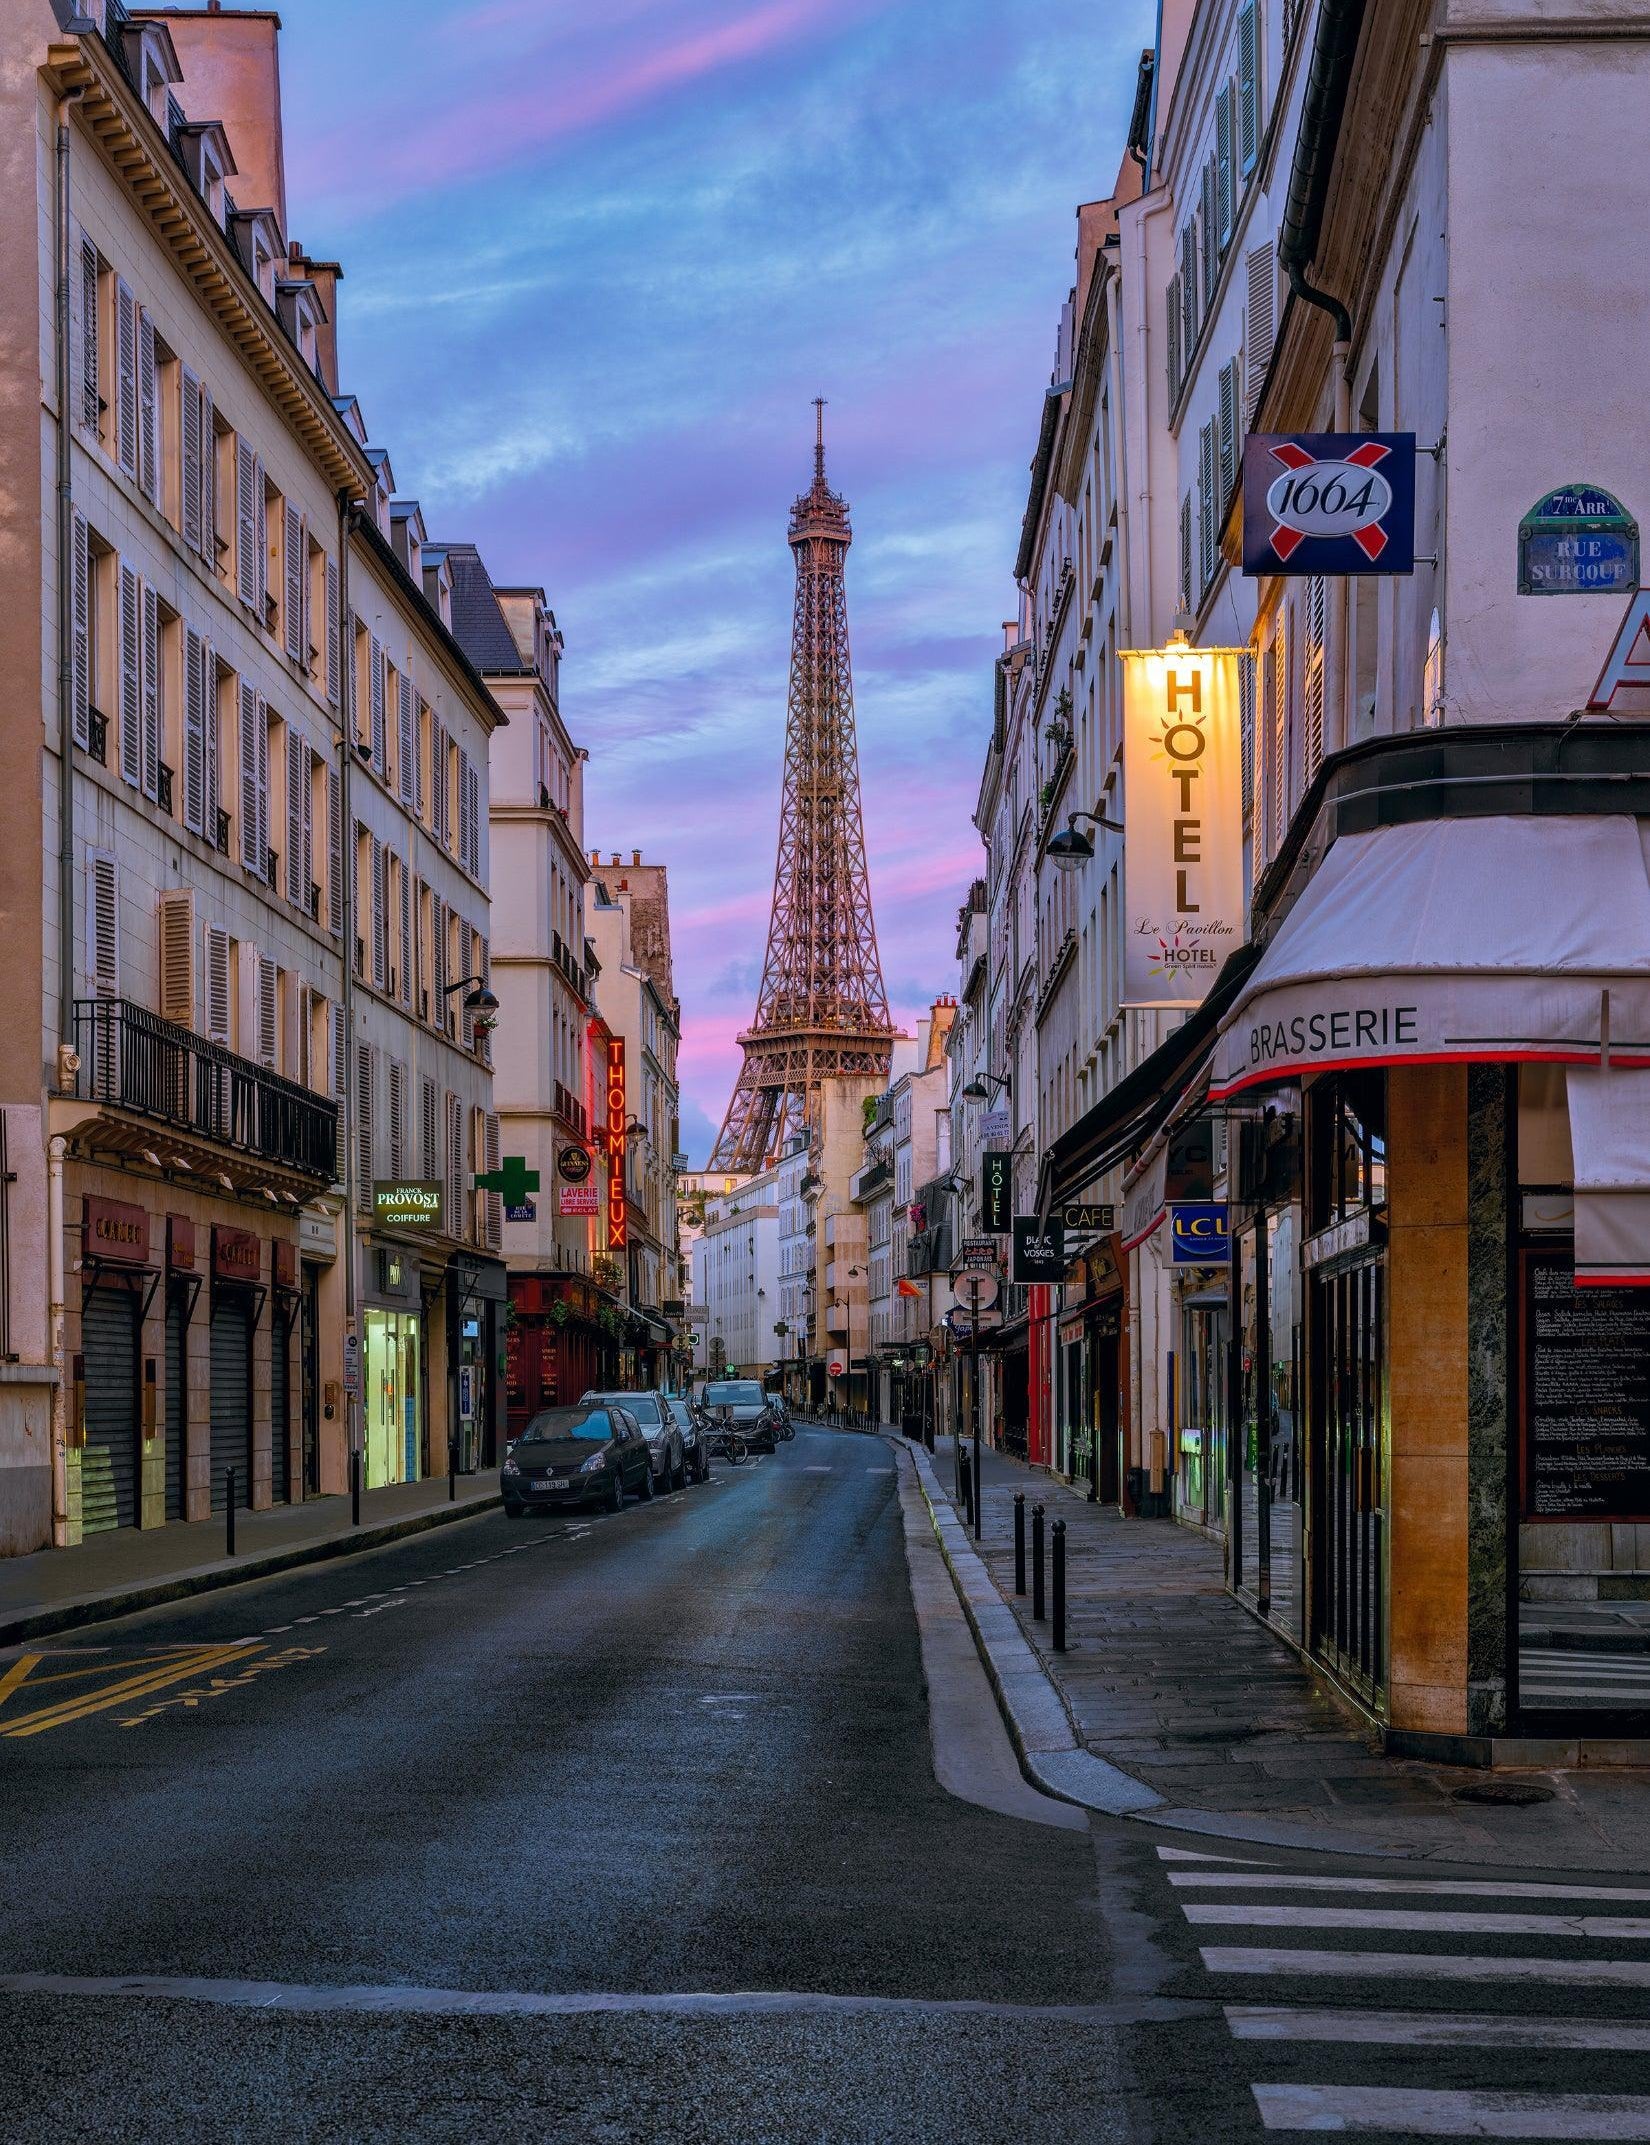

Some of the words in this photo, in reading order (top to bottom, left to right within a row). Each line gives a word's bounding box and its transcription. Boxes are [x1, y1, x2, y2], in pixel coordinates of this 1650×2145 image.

[1279, 471, 1377, 518] 1664
[1557, 541, 1601, 557] RUE
[1532, 564, 1625, 580] SURCOUF
[1165, 671, 1205, 912] HOTEL
[1134, 916, 1160, 934] Le
[1166, 919, 1234, 934] Pavillon
[1164, 949, 1216, 962] HOTEL
[1251, 1007, 1418, 1064] BRASSERIE
[609, 1043, 624, 1245] THOUMIEUX
[377, 1193, 439, 1204] PROVOST
[561, 1188, 598, 1197] LAVERIE
[992, 1160, 1003, 1225] HÔTEL
[387, 1214, 430, 1222] COIFFURE
[1066, 1208, 1111, 1226] CAFE
[1176, 1218, 1229, 1236] LCL
